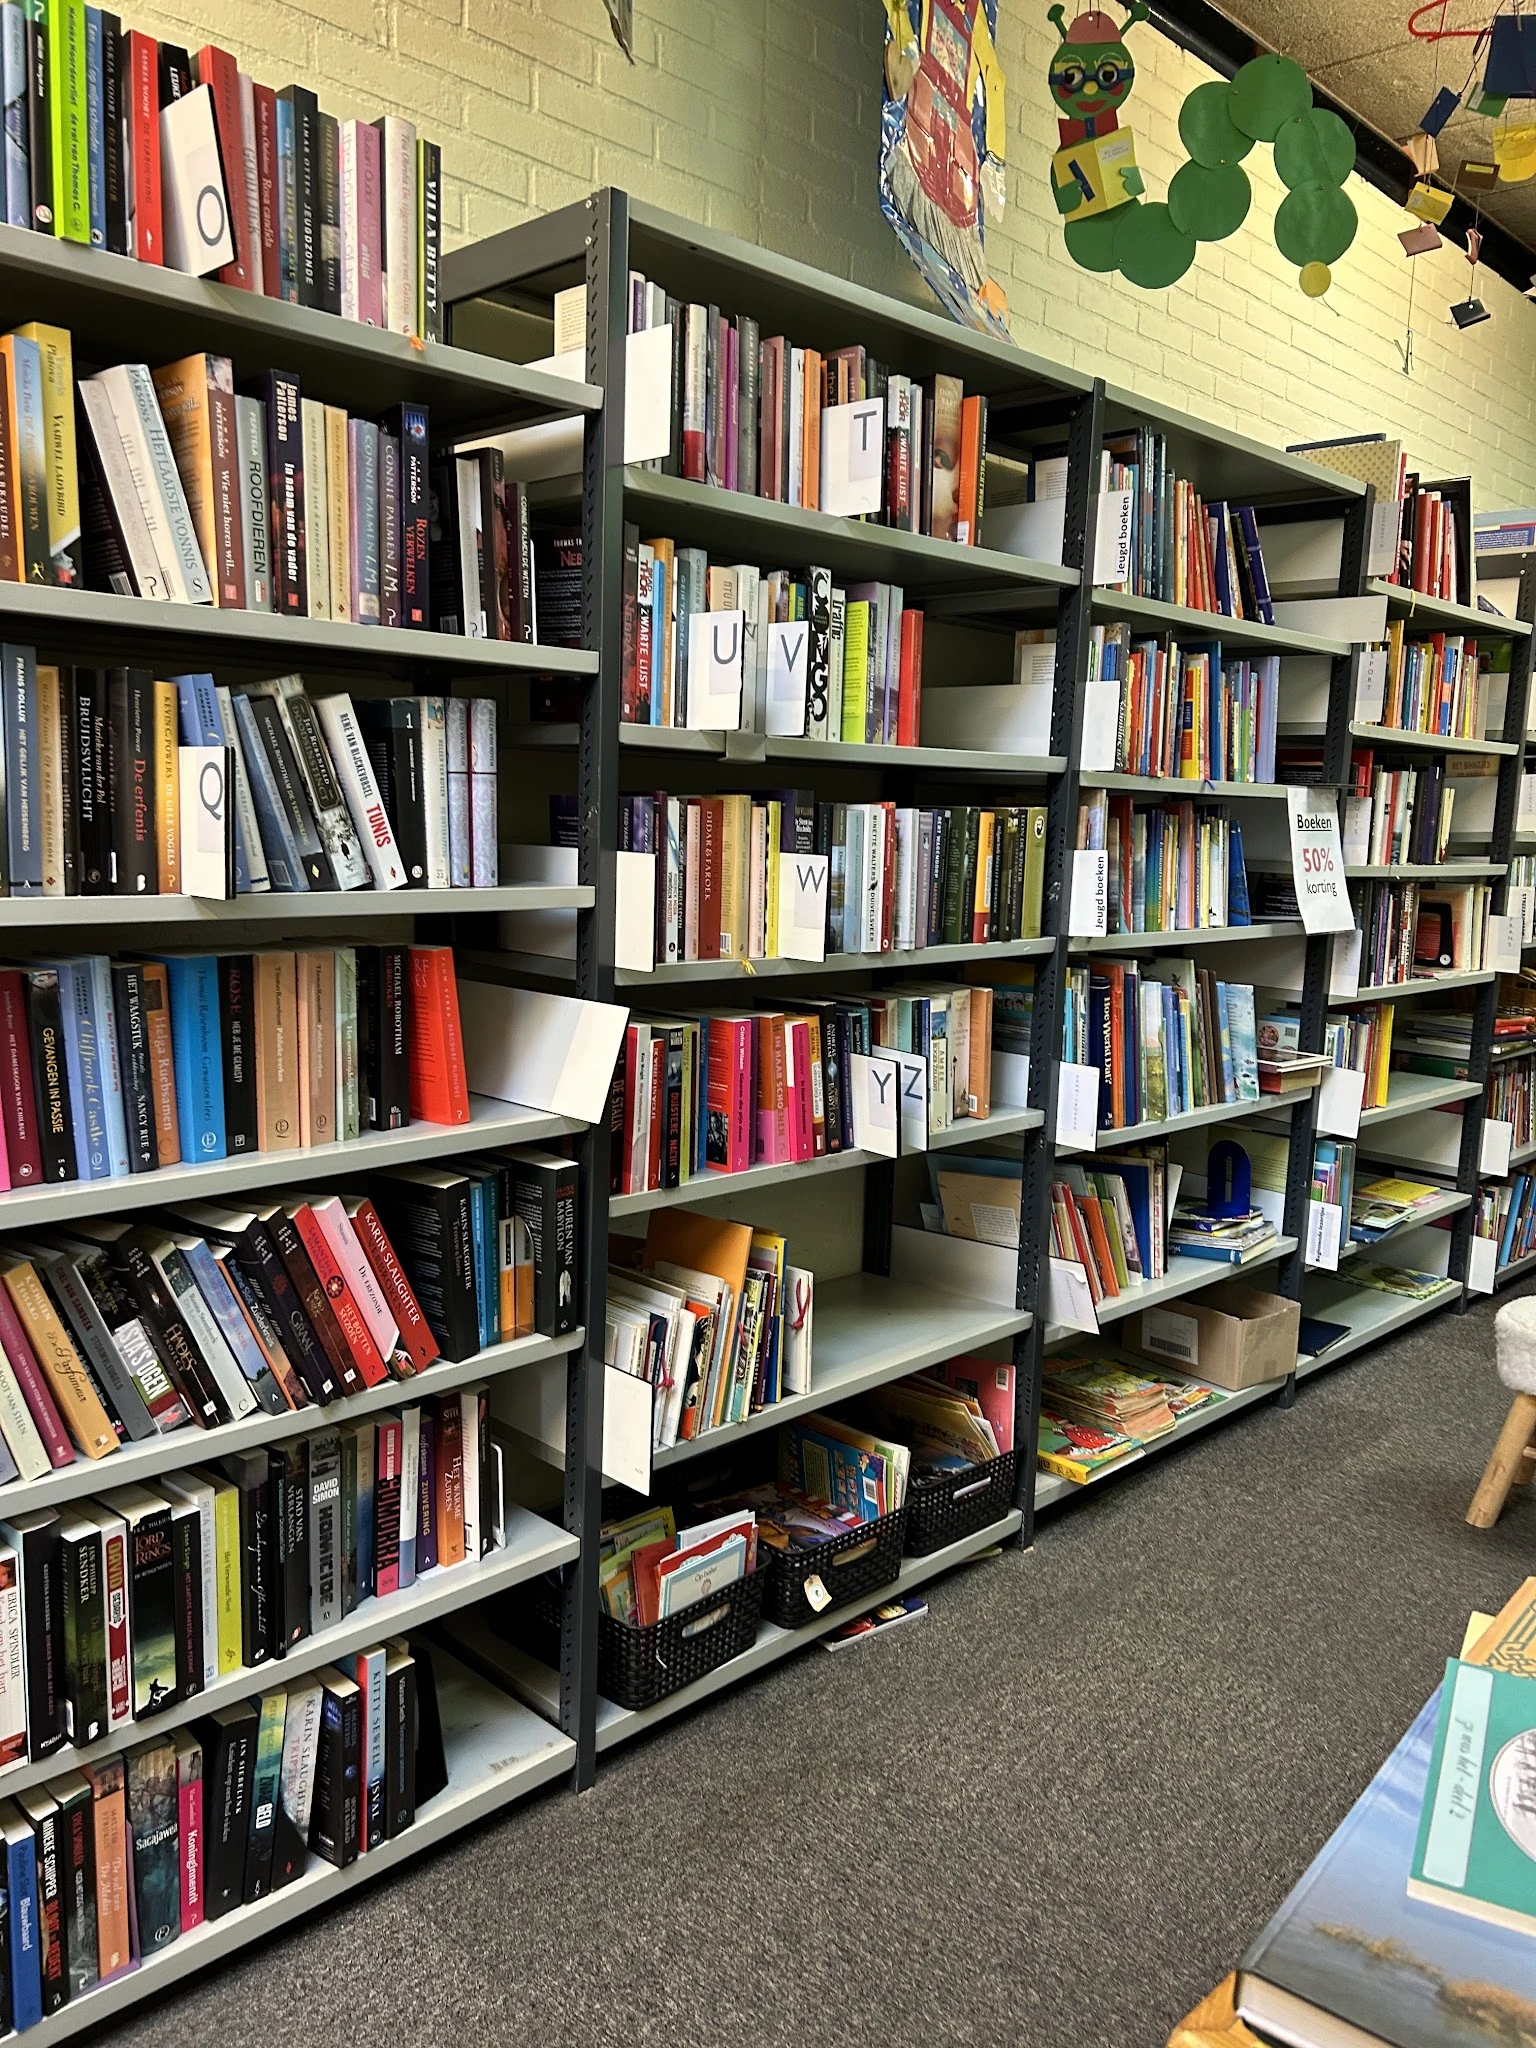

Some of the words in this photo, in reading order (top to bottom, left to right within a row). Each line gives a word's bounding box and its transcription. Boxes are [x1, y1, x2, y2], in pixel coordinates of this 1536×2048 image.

[262, 177, 271, 203] Rosa
[426, 180, 436, 238] VILLA
[197, 185, 225, 246] O
[263, 205, 273, 248] candida
[304, 203, 314, 285] JEUGDZONDE
[360, 243, 372, 278] altijd
[426, 243, 437, 313] BETTY
[130, 369, 150, 423] PARSONS
[276, 380, 288, 441] Patterson
[287, 384, 297, 422] James
[854, 411, 877, 451] T
[285, 463, 295, 473] In
[364, 435, 374, 491] CONNIE
[900, 431, 908, 473] ZWARTE
[221, 470, 230, 491] Wie
[385, 445, 394, 500] CONNIE
[410, 456, 418, 505] PATTERSON
[222, 493, 231, 514] niet
[285, 477, 295, 508] naam
[520, 496, 528, 525] CONNIE
[223, 516, 232, 543] horen
[249, 460, 266, 574] ROOFDIEREN
[366, 496, 375, 551] PALMEN
[386, 505, 395, 559] PALMEN
[1118, 496, 1130, 543] boeken
[287, 532, 296, 547] de
[416, 518, 427, 561] ROZEN
[288, 549, 297, 582] vader
[405, 525, 415, 595] VERWELKEN
[522, 557, 528, 568] DE
[1116, 543, 1128, 575] Jeugd
[640, 560, 648, 598] THOR
[640, 608, 649, 654] ZWARTE
[713, 623, 738, 664] U
[16, 657, 25, 687] FRANS
[780, 633, 803, 673] V
[640, 659, 648, 689] LIJST
[18, 689, 26, 722] POLLUX
[340, 713, 353, 732] RENÉ
[95, 716, 104, 753] Marieke
[345, 732, 356, 747] VAN
[19, 748, 27, 778] GELIJK
[79, 696, 92, 822] BRUIDSVLUCHT
[95, 755, 103, 771] van
[133, 759, 146, 783] De
[350, 749, 373, 798] RIJCKEVORSEL
[20, 779, 28, 797] VAN
[96, 772, 104, 787] der
[96, 789, 106, 804] Pol
[200, 761, 224, 821] Q
[21, 799, 29, 852] HEISENBERG
[134, 786, 145, 842] erfenis
[366, 803, 391, 848] TUNIS
[1297, 814, 1332, 829] Boeken
[705, 848, 713, 858] &
[1302, 847, 1334, 873] 50%
[797, 864, 826, 892] W
[1095, 856, 1105, 891] boeken
[1306, 880, 1337, 897] korting
[1095, 892, 1105, 929] Jeugd
[126, 974, 138, 996] HET
[394, 954, 402, 998] MICHAEL
[130, 997, 144, 1050] WAAGSTUK
[154, 1016, 169, 1054] Helga
[394, 1000, 402, 1055] ROBOTHAM
[775, 1036, 782, 1048] IN
[42, 1028, 56, 1086] GEVANGEN
[78, 1020, 96, 1094] Cliffrock
[775, 1050, 783, 1079] HAAR
[49, 1088, 58, 1100] IN
[158, 1058, 172, 1131] Ruebsamen
[612, 1079, 624, 1095] DE
[871, 1069, 892, 1104] Y
[904, 1064, 923, 1100] Z
[50, 1102, 63, 1134] PASSIE
[85, 1098, 104, 1146] Castle
[138, 1095, 148, 1128] NANCY
[611, 1097, 623, 1132] STALIN
[670, 1092, 679, 1135] DUISTERE
[776, 1081, 785, 1136] SCHOENEN
[827, 1082, 836, 1129] BABYLON
[140, 1131, 151, 1148] RUE
[669, 1139, 679, 1167] NACHT
[459, 1198, 468, 1230] KARIN
[557, 1201, 565, 1251] BABYLON
[564, 1198, 573, 1240] MUREN
[462, 1232, 472, 1290] SLAUGHTER
[565, 1241, 573, 1265] VAN
[1315, 1229, 1323, 1262] Beginnende
[364, 1212, 388, 1252] KARIN
[383, 1252, 419, 1326] SLAUGHTER
[339, 1310, 358, 1346] SEIZOEN
[344, 1302, 356, 1322] HET
[351, 1322, 372, 1356] BOTTEN
[115, 1320, 149, 1372] ASTA'S
[136, 1362, 170, 1400] OGEN
[313, 1477, 338, 1494] DAVID
[453, 1456, 461, 1479] HET
[295, 1488, 303, 1517] STAD
[312, 1487, 340, 1505] SIMON
[422, 1480, 430, 1536] ZUIVERING
[445, 1472, 453, 1512] ZUIDEN
[287, 1485, 295, 1554] VERLANGEN
[377, 1480, 400, 1571] GOMORRA
[78, 1545, 90, 1604] SENDKER
[319, 1505, 333, 1607] HOMICIDE
[224, 1564, 232, 1597] Verwende
[7, 1591, 17, 1624] ERICA
[10, 1628, 20, 1680] SPINDLER
[373, 1671, 381, 1714] KITTY
[303, 1698, 315, 1743] KARIN
[372, 1719, 381, 1768] SEWELL
[235, 1760, 246, 1814] SIEBELINK
[295, 1747, 312, 1823] SLAUGHTER
[371, 1775, 380, 1820] IJSVAL
[42, 1817, 55, 1852] MINEKE
[255, 1802, 273, 1829] GELD
[135, 1823, 178, 1852] Sacajawea
[44, 1855, 56, 1899] SCHIPPER
[186, 1829, 198, 1906] Koninginnenrit
[46, 1900, 58, 1932] BLOOT
[48, 1942, 61, 1980] BEDEKT
